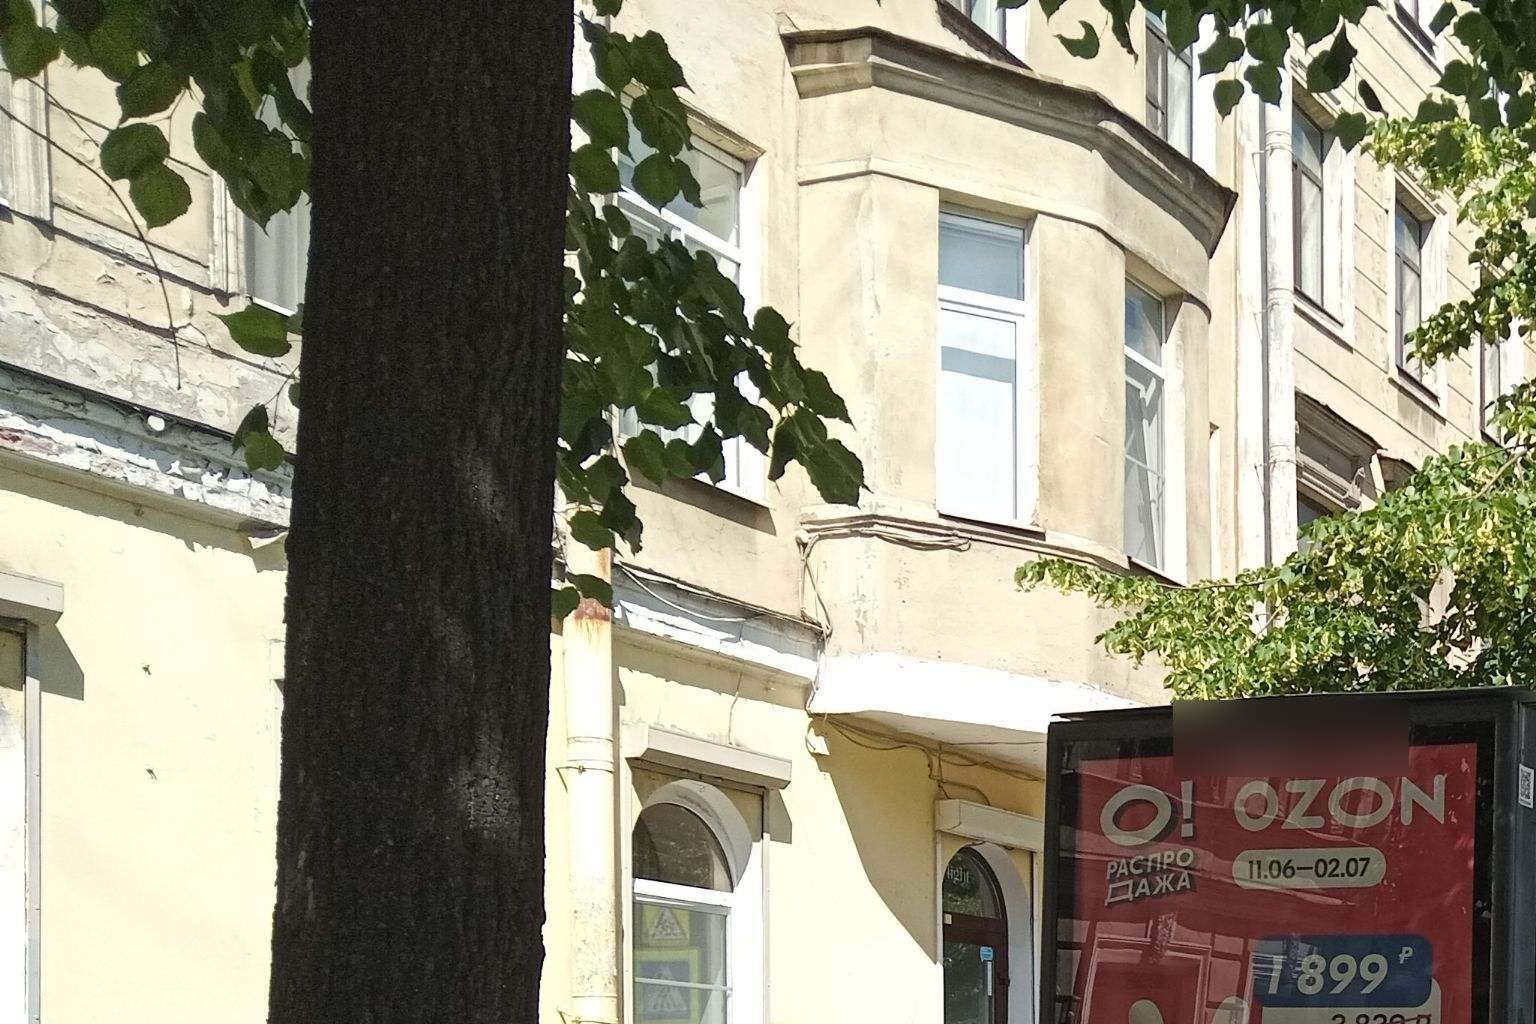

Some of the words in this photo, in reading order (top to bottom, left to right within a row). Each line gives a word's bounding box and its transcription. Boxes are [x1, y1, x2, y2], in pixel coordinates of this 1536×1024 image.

[1234, 774, 1447, 831] OZON
[1106, 848, 1194, 880] РАСПРО
[1104, 870, 1192, 906] ДАЖА
